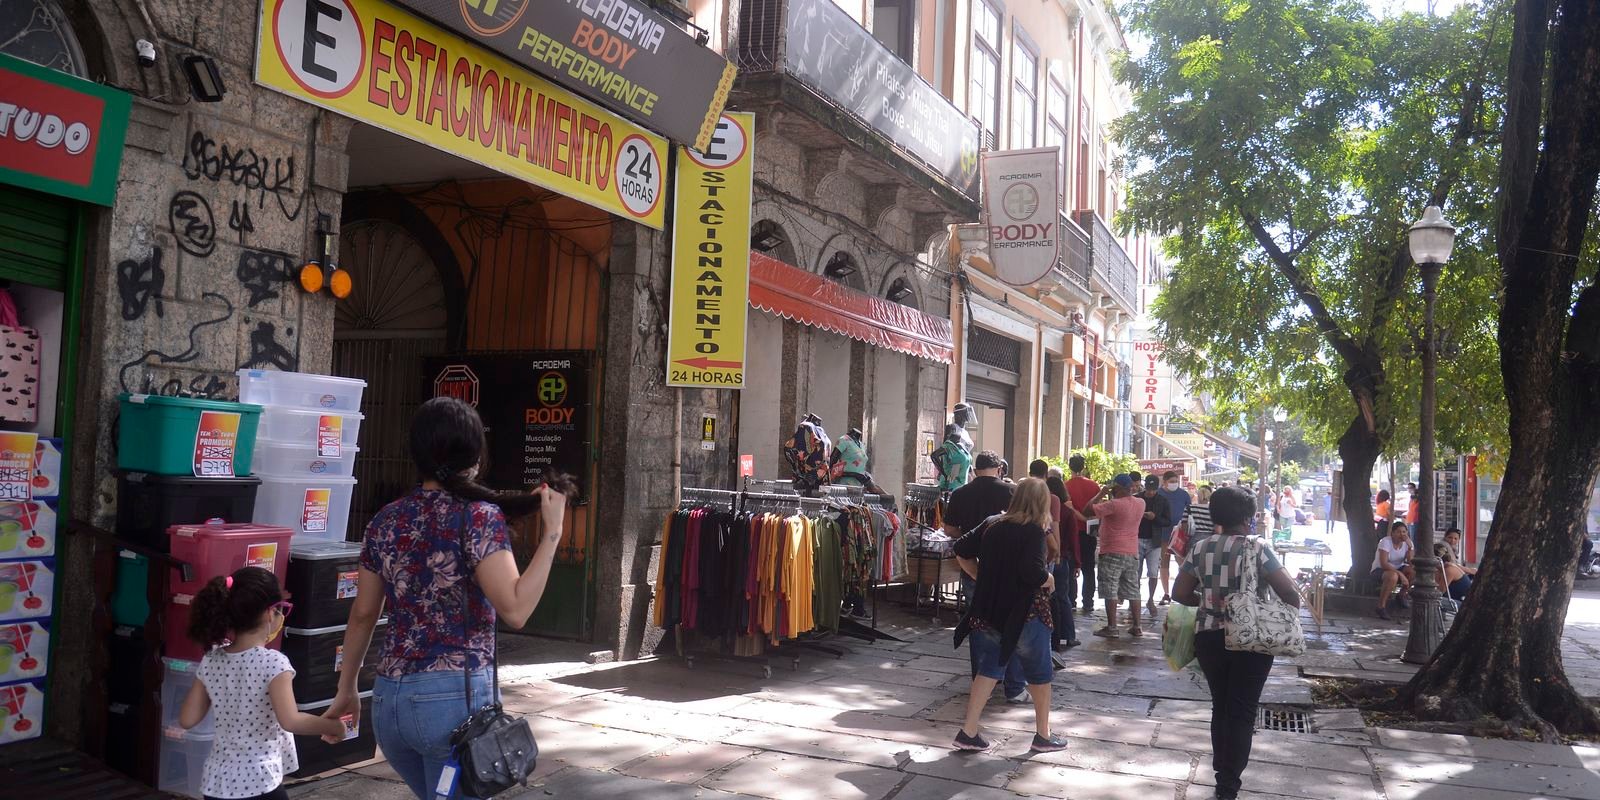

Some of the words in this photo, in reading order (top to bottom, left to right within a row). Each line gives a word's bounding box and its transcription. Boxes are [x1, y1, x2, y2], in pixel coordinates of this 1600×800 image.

[301, 0, 343, 83] E
[571, 18, 638, 70] BODY
[517, 25, 659, 117] PERFORMANCE
[876, 61, 905, 100] Pilates
[912, 89, 932, 124] Muay
[368, 18, 613, 192] ESTACIONAMENTO
[882, 96, 905, 128] Boxe
[0, 102, 91, 155] TUDO
[624, 144, 653, 183] 24
[999, 172, 1042, 181] ACADEMIA
[620, 182, 654, 205] HORAS
[993, 239, 1053, 249] ERFORMANCE
[532, 360, 571, 369] ACADEMIA
[671, 370, 688, 382] 24
[692, 370, 744, 384] HORAS
[1144, 354, 1158, 410] VITORIA
[525, 408, 575, 424] BODY
[525, 434, 562, 442] Musculação
[525, 445, 544, 453] Dança
[523, 467, 542, 475] Jump
[524, 456, 552, 465] Spinning
